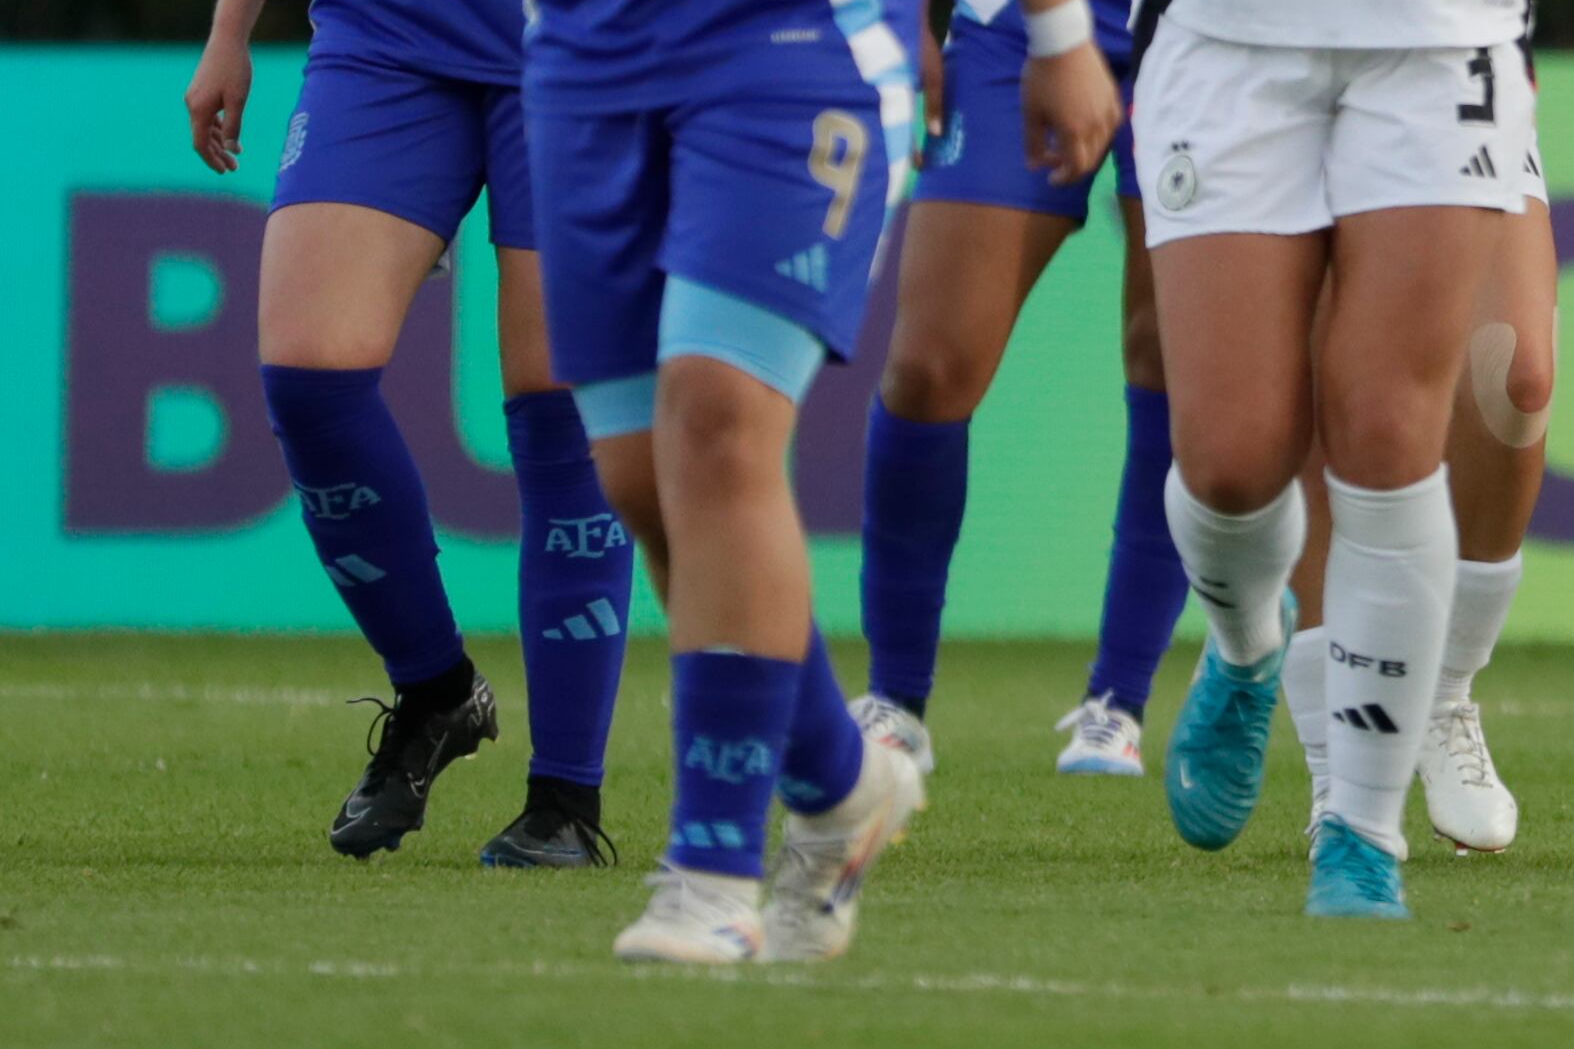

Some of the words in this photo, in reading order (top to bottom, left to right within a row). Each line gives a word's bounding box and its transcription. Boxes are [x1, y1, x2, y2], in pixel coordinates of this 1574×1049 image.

[808, 108, 869, 241] 9
[544, 513, 627, 558] AFA
[1329, 641, 1408, 678] DFB
